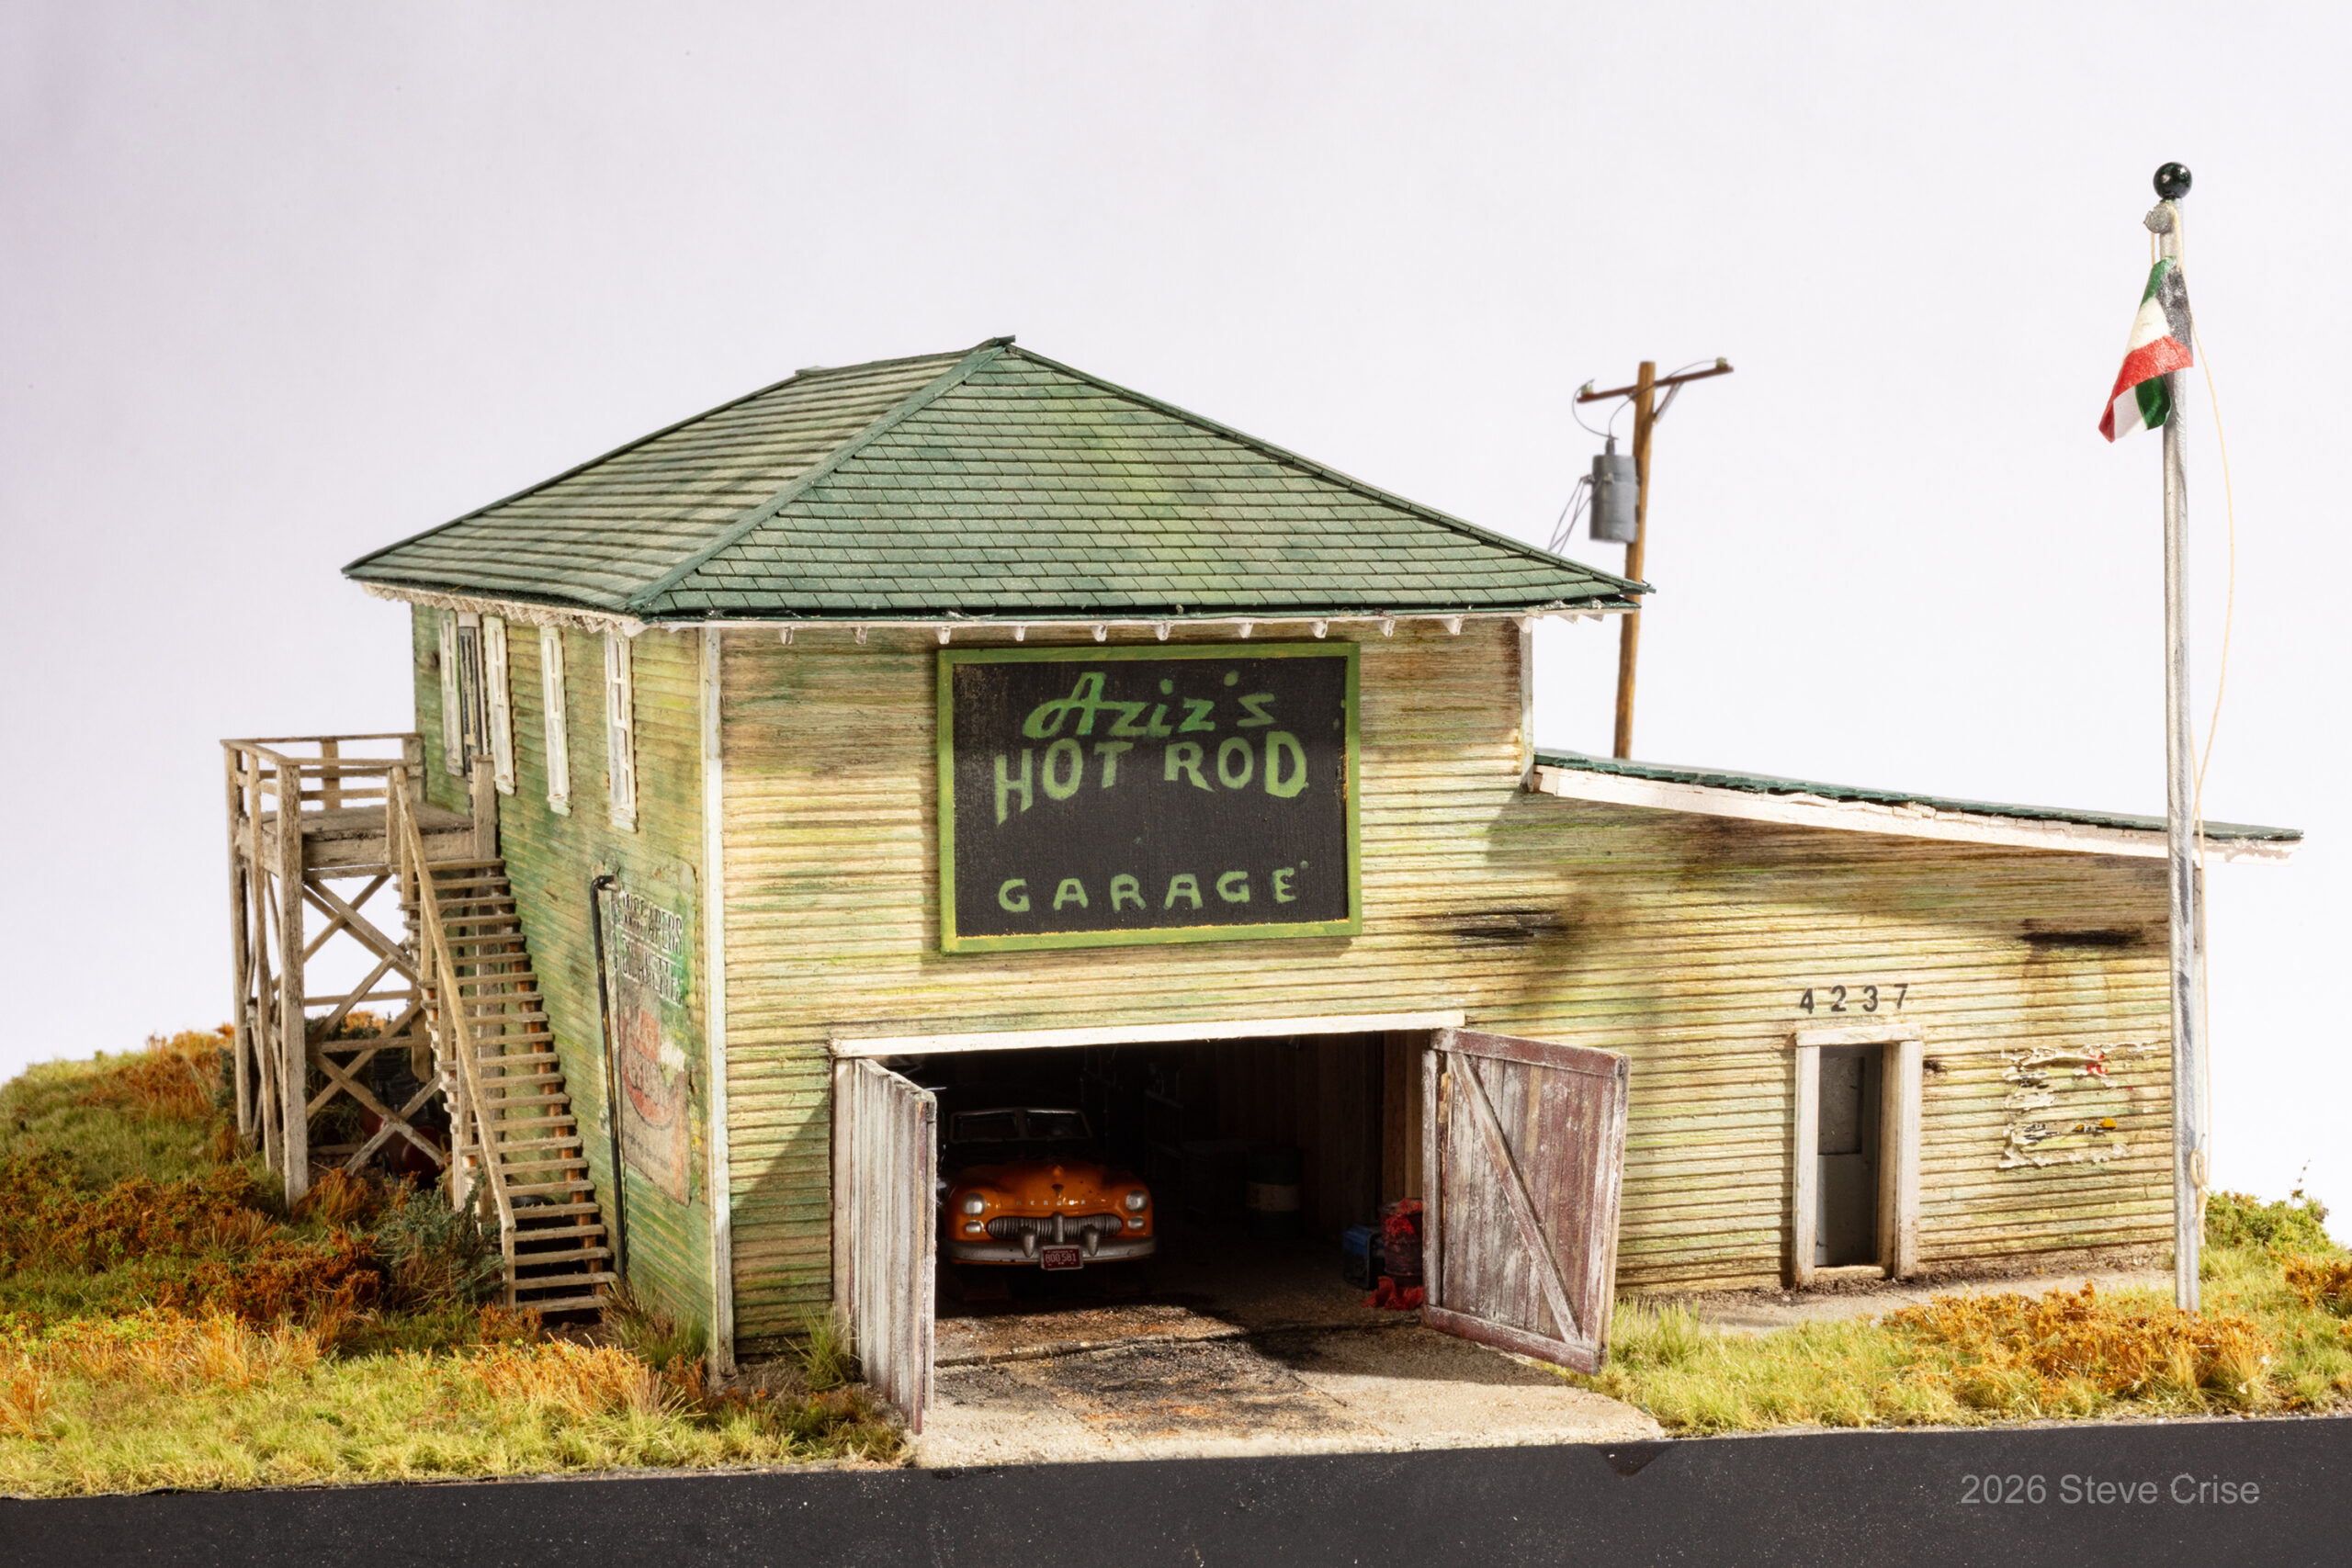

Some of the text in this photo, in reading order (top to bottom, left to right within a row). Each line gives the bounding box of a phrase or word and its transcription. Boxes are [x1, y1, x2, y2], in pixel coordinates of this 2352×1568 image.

[1022, 671, 1277, 739] Aziz's
[993, 730, 1309, 828] HOT ROD
[998, 867, 1297, 913] GARAGE
[1799, 983, 1908, 1014] 4237
